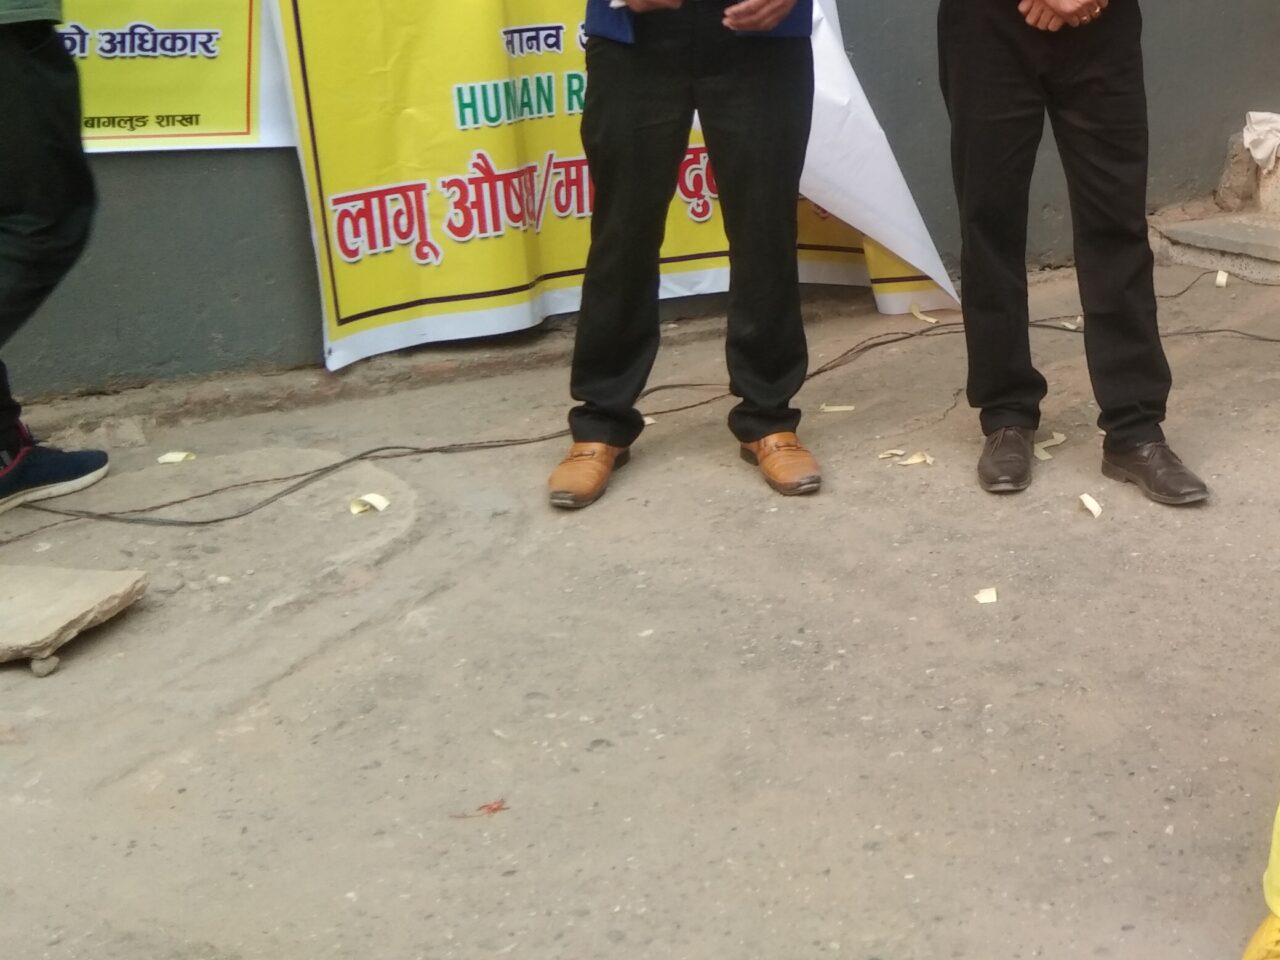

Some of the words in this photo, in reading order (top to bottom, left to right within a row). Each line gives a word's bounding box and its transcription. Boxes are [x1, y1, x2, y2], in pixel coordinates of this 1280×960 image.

[99, 24, 219, 54] अधिकार
[155, 114, 200, 127] शाखा
[332, 183, 440, 260] लागू
